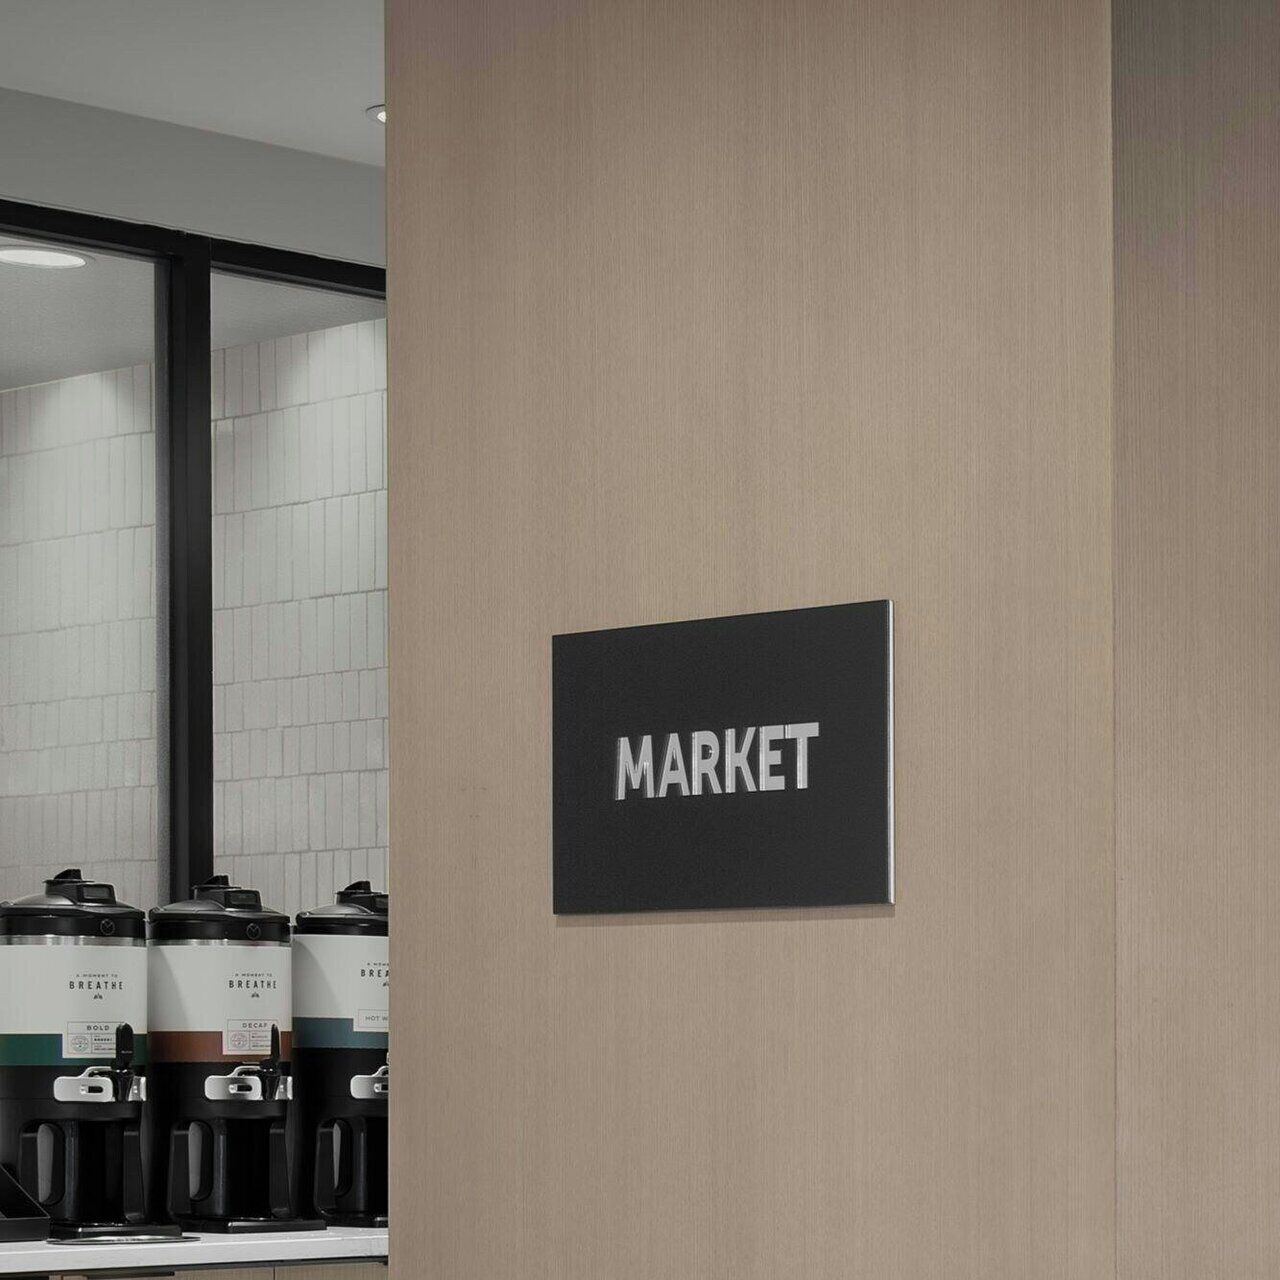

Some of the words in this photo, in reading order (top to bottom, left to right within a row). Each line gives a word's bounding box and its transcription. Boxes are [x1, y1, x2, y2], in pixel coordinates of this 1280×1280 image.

[615, 721, 820, 801] MARKET
[360, 968, 389, 978] BREA
[68, 980, 124, 990] BREATHE
[228, 980, 278, 989] BREATHE
